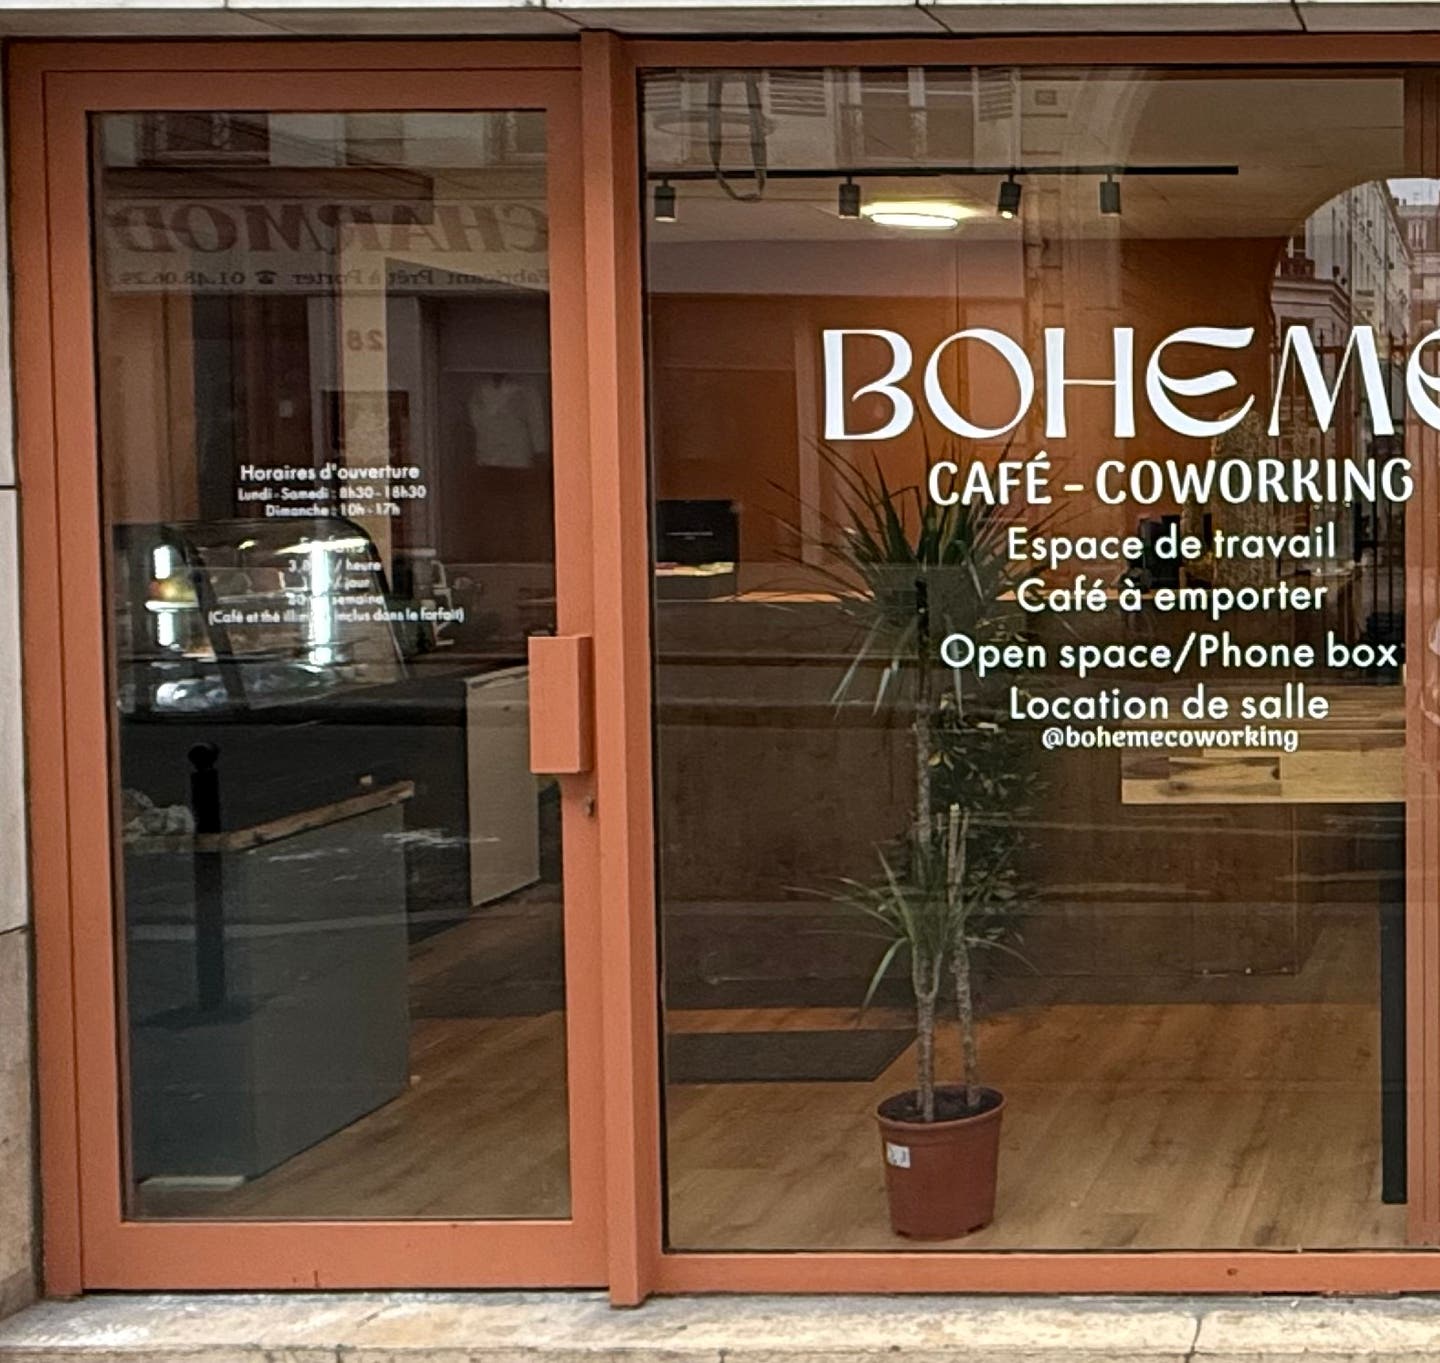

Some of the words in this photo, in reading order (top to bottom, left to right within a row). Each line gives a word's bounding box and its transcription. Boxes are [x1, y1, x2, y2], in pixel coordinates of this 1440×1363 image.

[240, 464, 317, 481] Horaires
[319, 462, 420, 481] d'ouverture
[929, 451, 1052, 505] CAFÉ
[1096, 457, 1414, 505] COWORKING
[237, 487, 273, 501] Lundi
[281, 486, 330, 501] Samedi
[265, 502, 330, 517] Dimanche
[375, 502, 401, 516] 17h
[1008, 527, 1143, 568] Espace
[1155, 522, 1201, 559] de
[1214, 521, 1335, 559] travail
[345, 559, 382, 572] heure
[1017, 577, 1107, 612] Café
[1119, 578, 1141, 611] à
[1154, 581, 1329, 621] emporter
[372, 608, 404, 621] dans
[405, 607, 419, 621] le
[940, 634, 1046, 677] Open
[1059, 631, 1314, 677] space/Phone
[1327, 630, 1399, 667] box
[1011, 687, 1168, 720] Location
[1182, 683, 1229, 720] de
[1241, 682, 1330, 720] salle
[1042, 725, 1299, 753] @bohemecoworking
